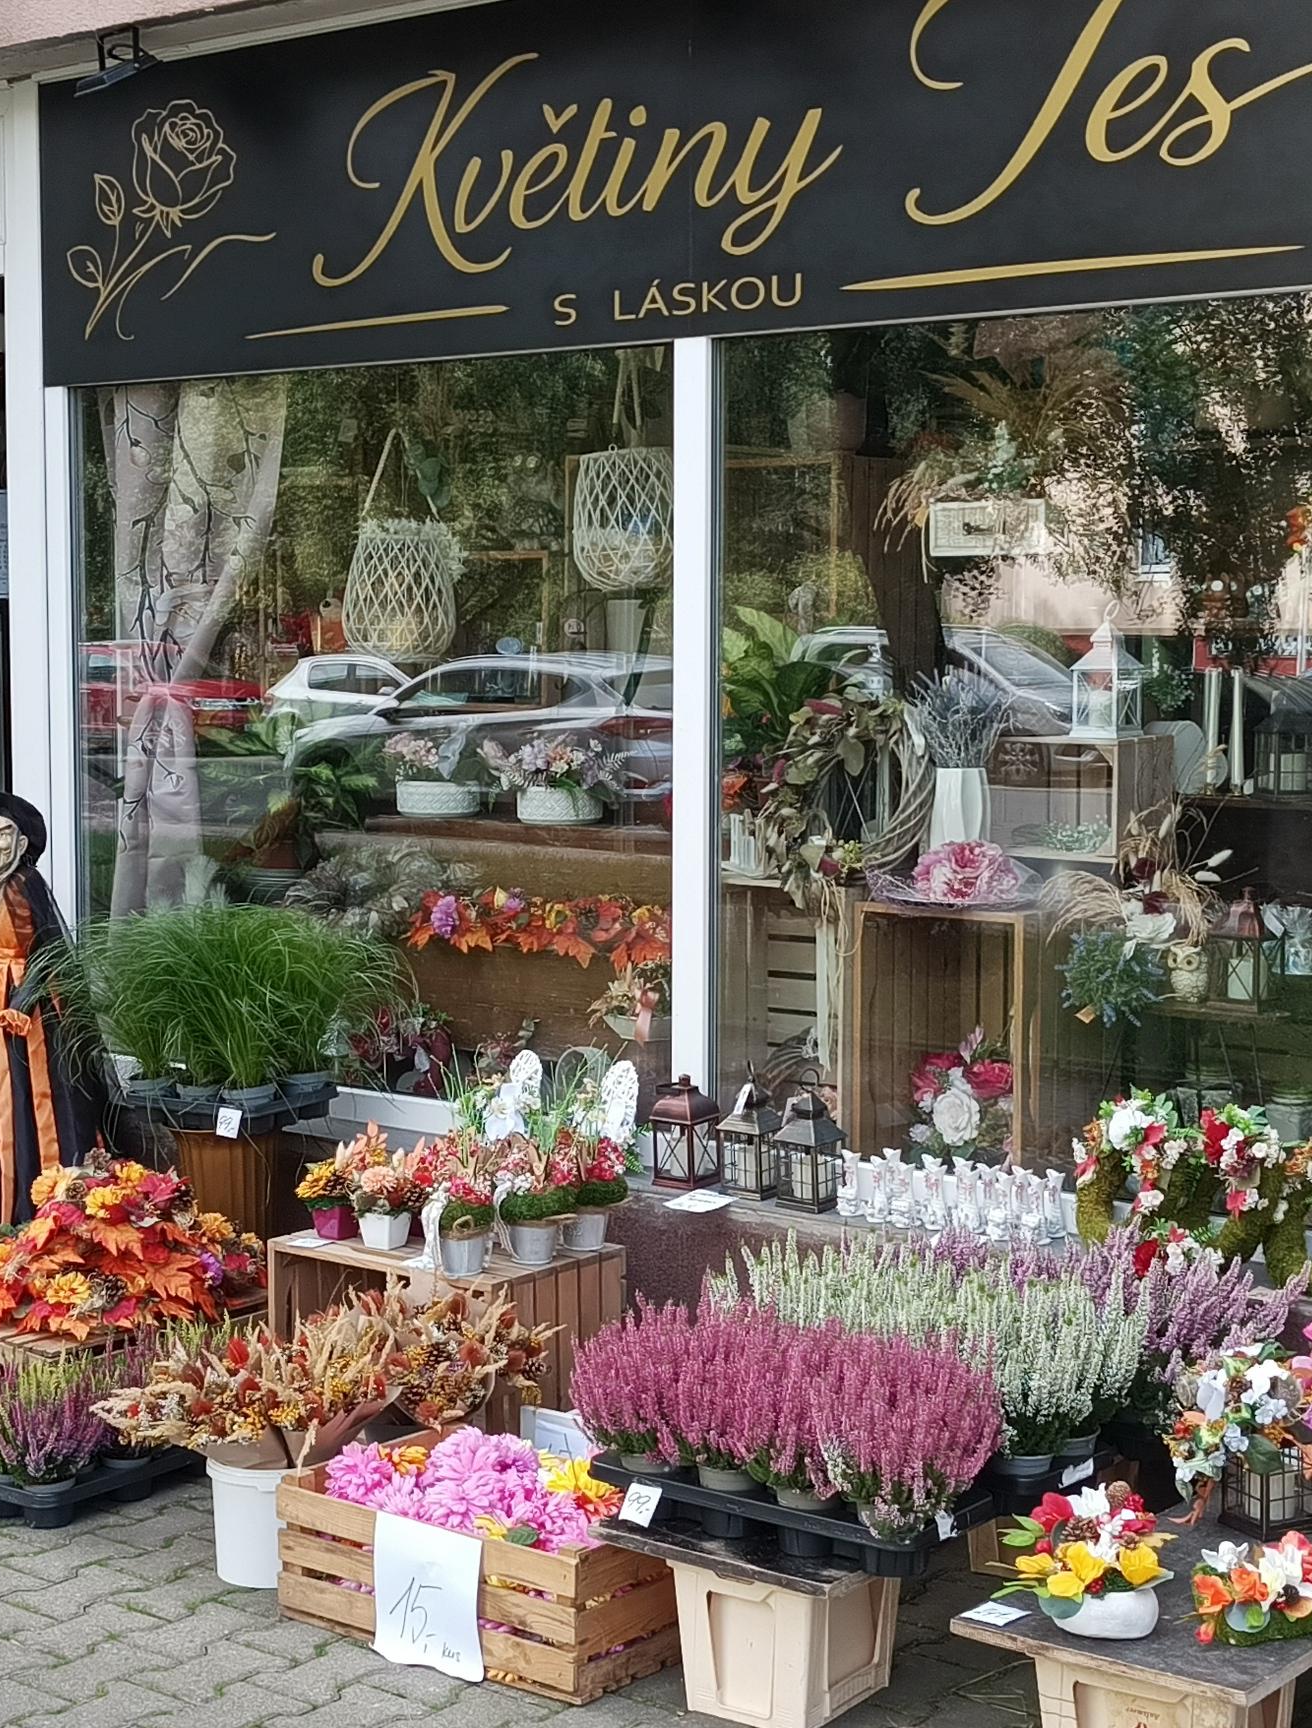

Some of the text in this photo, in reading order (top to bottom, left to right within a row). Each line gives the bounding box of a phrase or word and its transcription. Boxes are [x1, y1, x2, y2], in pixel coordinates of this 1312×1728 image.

[312, 52, 837, 288] Květiny
[552, 271, 803, 327] S LÁSKOU
